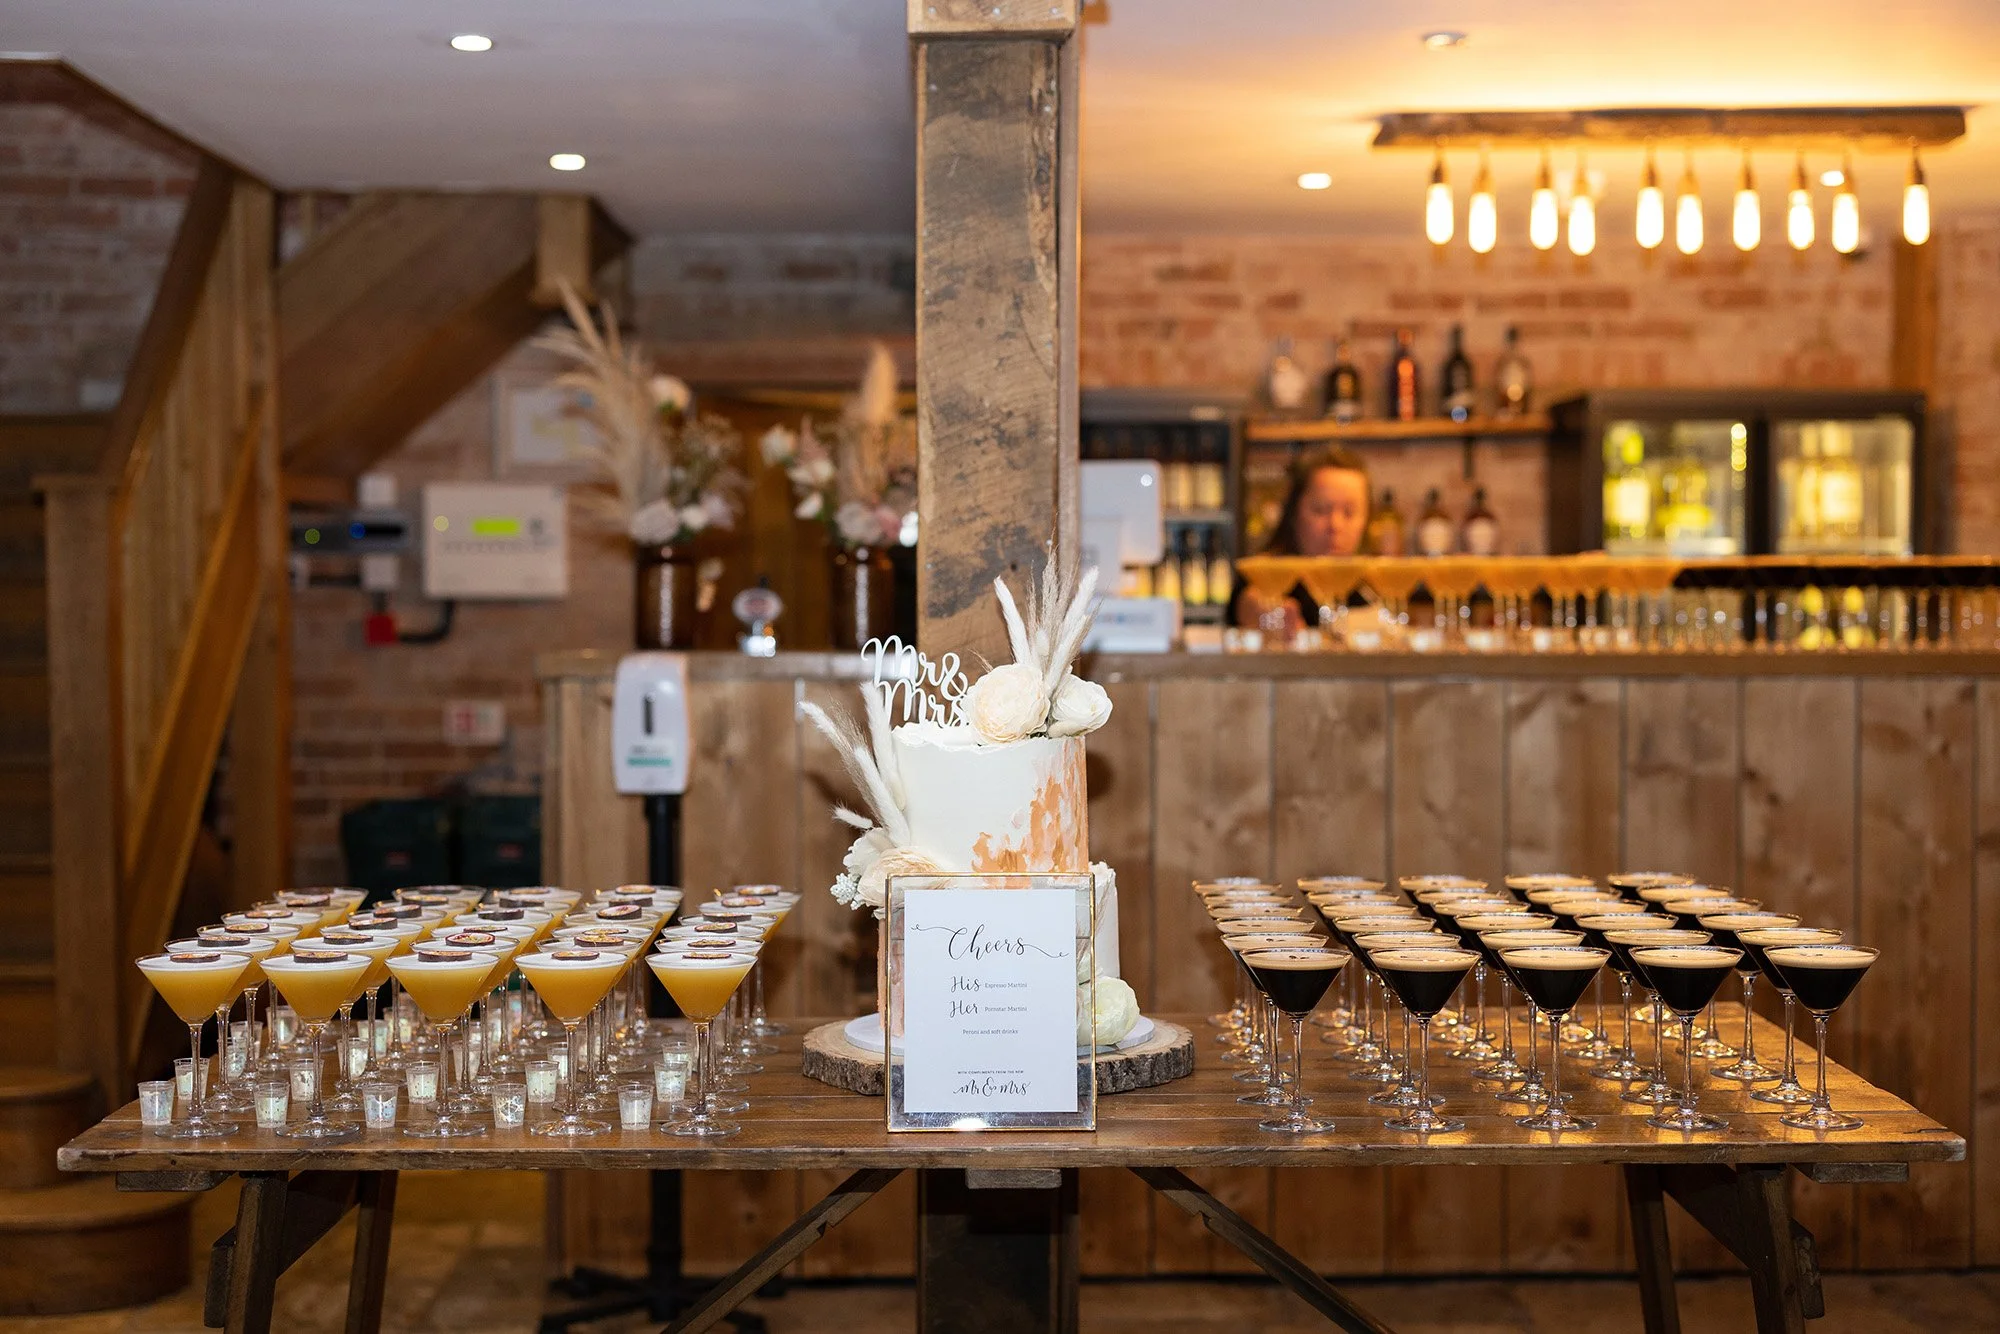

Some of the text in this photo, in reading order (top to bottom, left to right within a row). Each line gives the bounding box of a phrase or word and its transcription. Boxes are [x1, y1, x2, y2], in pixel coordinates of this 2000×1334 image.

[876, 678, 969, 728] Mrs
[951, 976, 980, 993] His
[950, 1000, 978, 1018] Her
[982, 1076, 997, 1097] &
